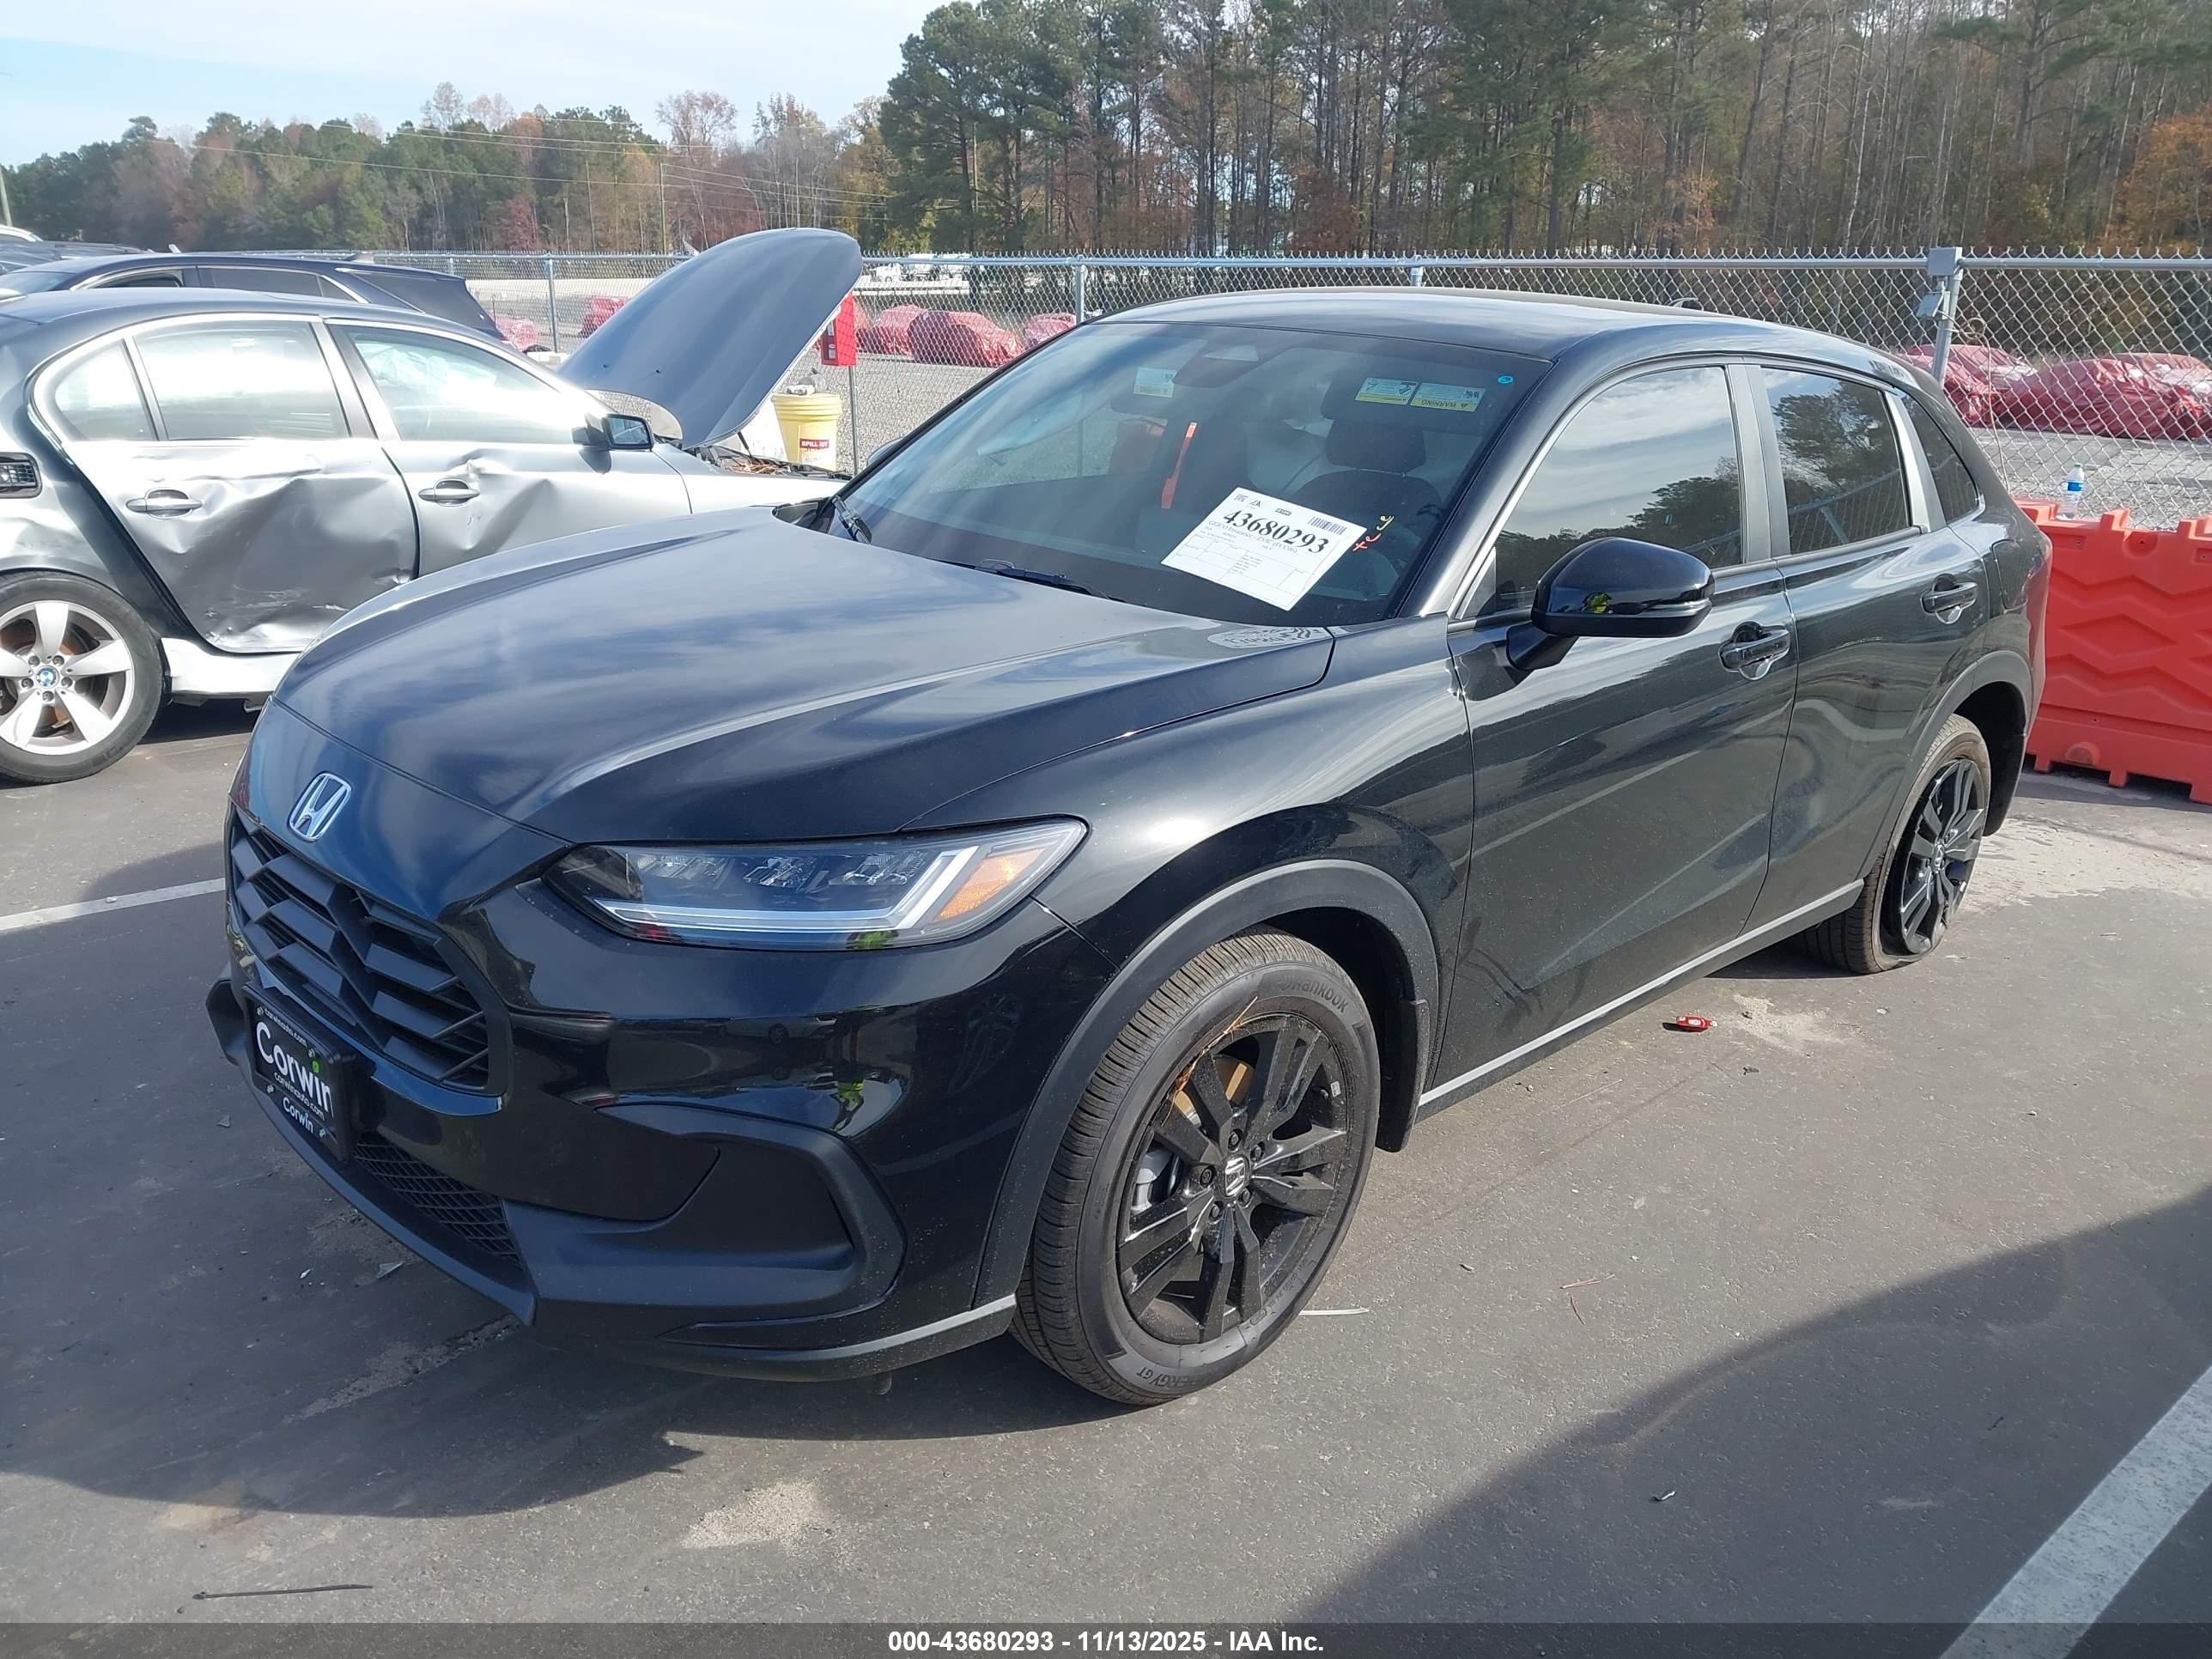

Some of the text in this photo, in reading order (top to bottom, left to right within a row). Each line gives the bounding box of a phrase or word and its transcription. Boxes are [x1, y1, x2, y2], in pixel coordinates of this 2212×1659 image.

[1223, 510, 1330, 554] 43680293
[256, 1022, 333, 1117] Corwin
[274, 1072, 325, 1121] corwinauto.com
[283, 1097, 313, 1133] Corwin
[1135, 1367, 1154, 1380] GT
